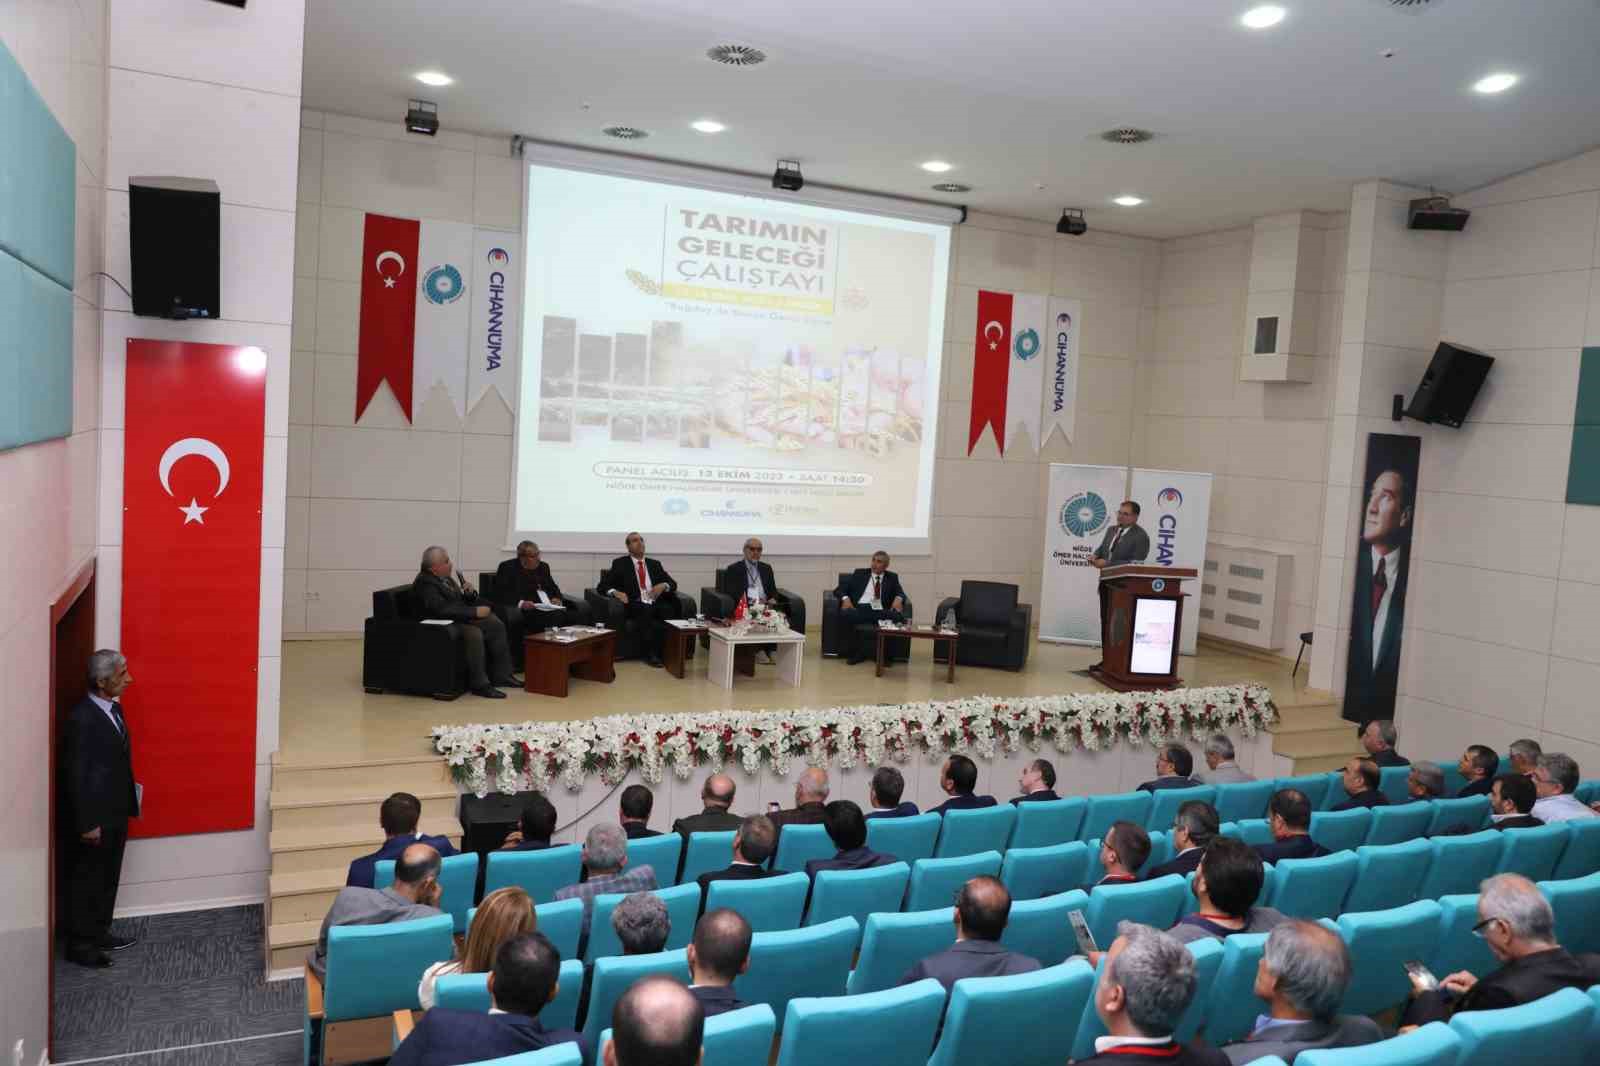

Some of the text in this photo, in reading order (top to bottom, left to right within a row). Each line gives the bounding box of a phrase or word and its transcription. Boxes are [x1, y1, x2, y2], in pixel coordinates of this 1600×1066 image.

[680, 209, 827, 245] TARIMIN
[678, 237, 825, 270] GELECEĞİ
[677, 260, 824, 293] ÇALIŞTAYI
[606, 465, 645, 476] PANEL
